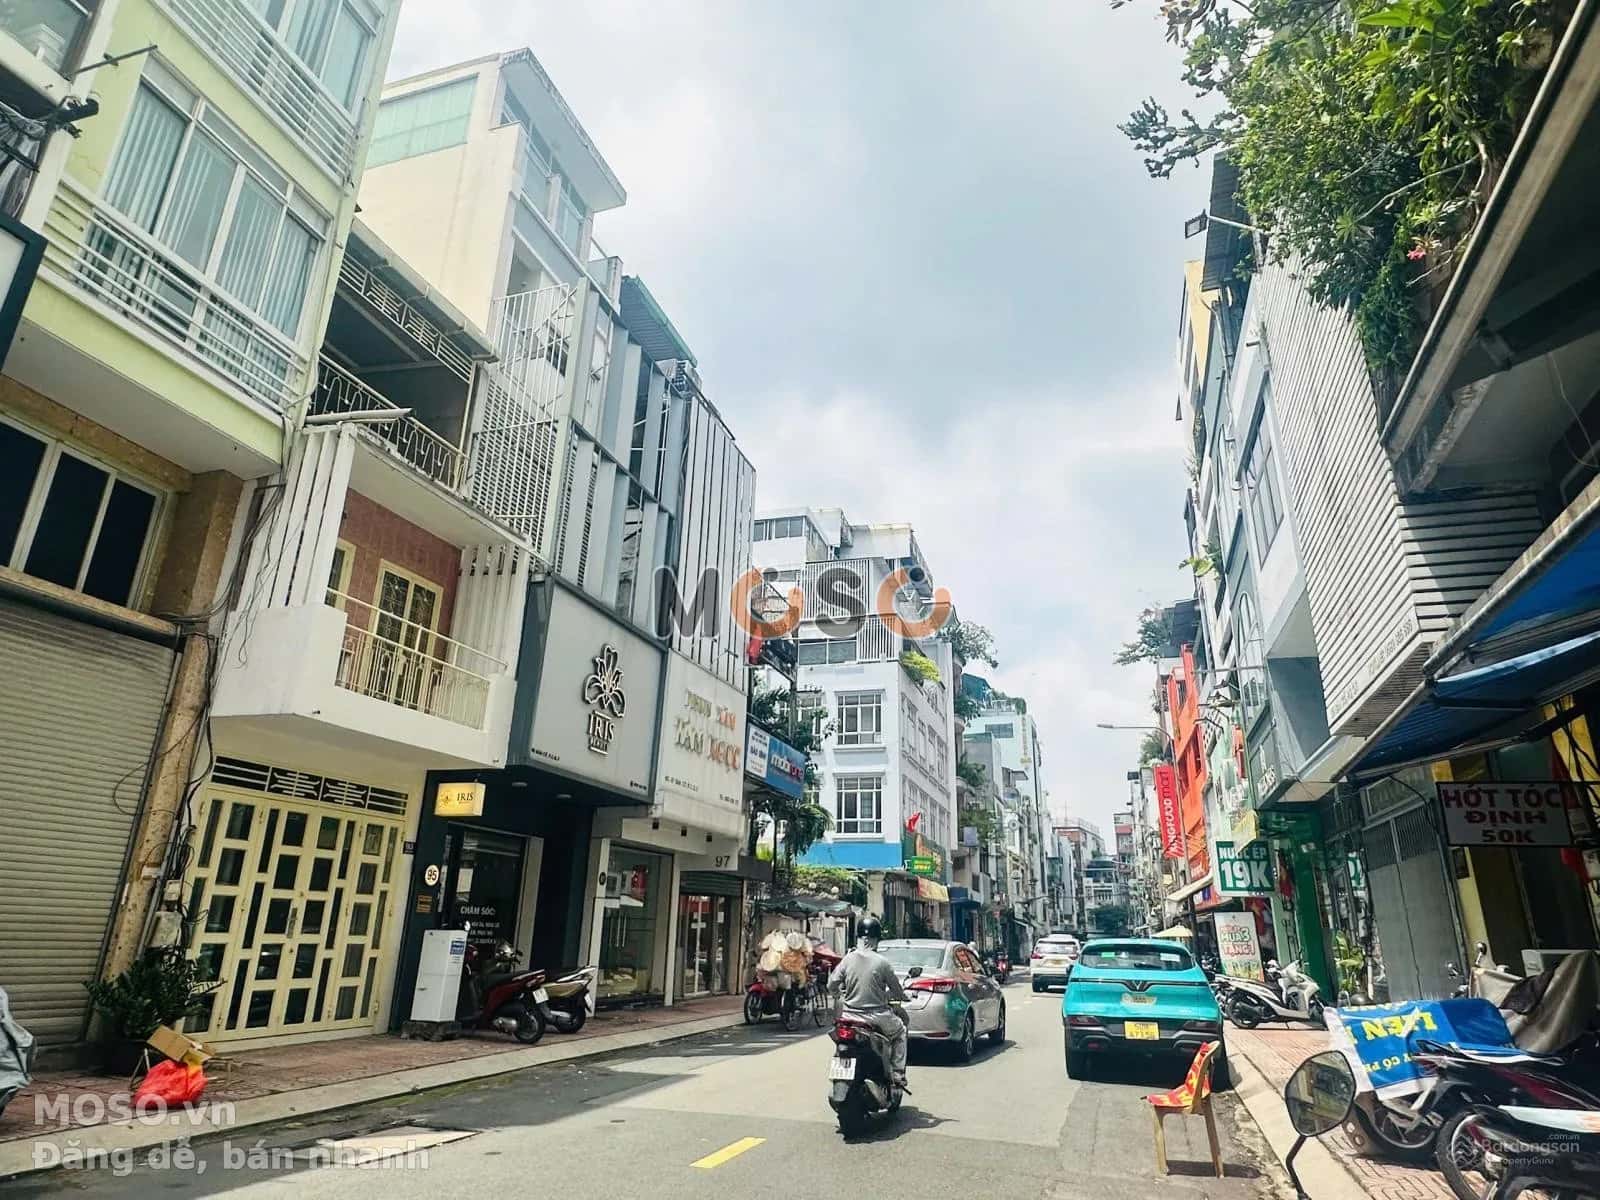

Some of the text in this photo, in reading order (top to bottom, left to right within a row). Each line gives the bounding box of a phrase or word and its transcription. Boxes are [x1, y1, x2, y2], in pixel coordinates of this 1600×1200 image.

[588, 714, 616, 743] IRIS
[456, 792, 474, 801] IRIS
[1442, 783, 1562, 808] HỚT TÓC
[1482, 829, 1537, 843] 50K
[715, 855, 730, 867] 97
[427, 869, 437, 880] 95
[1220, 861, 1272, 889] 19K
[1220, 931, 1241, 942] MUA
